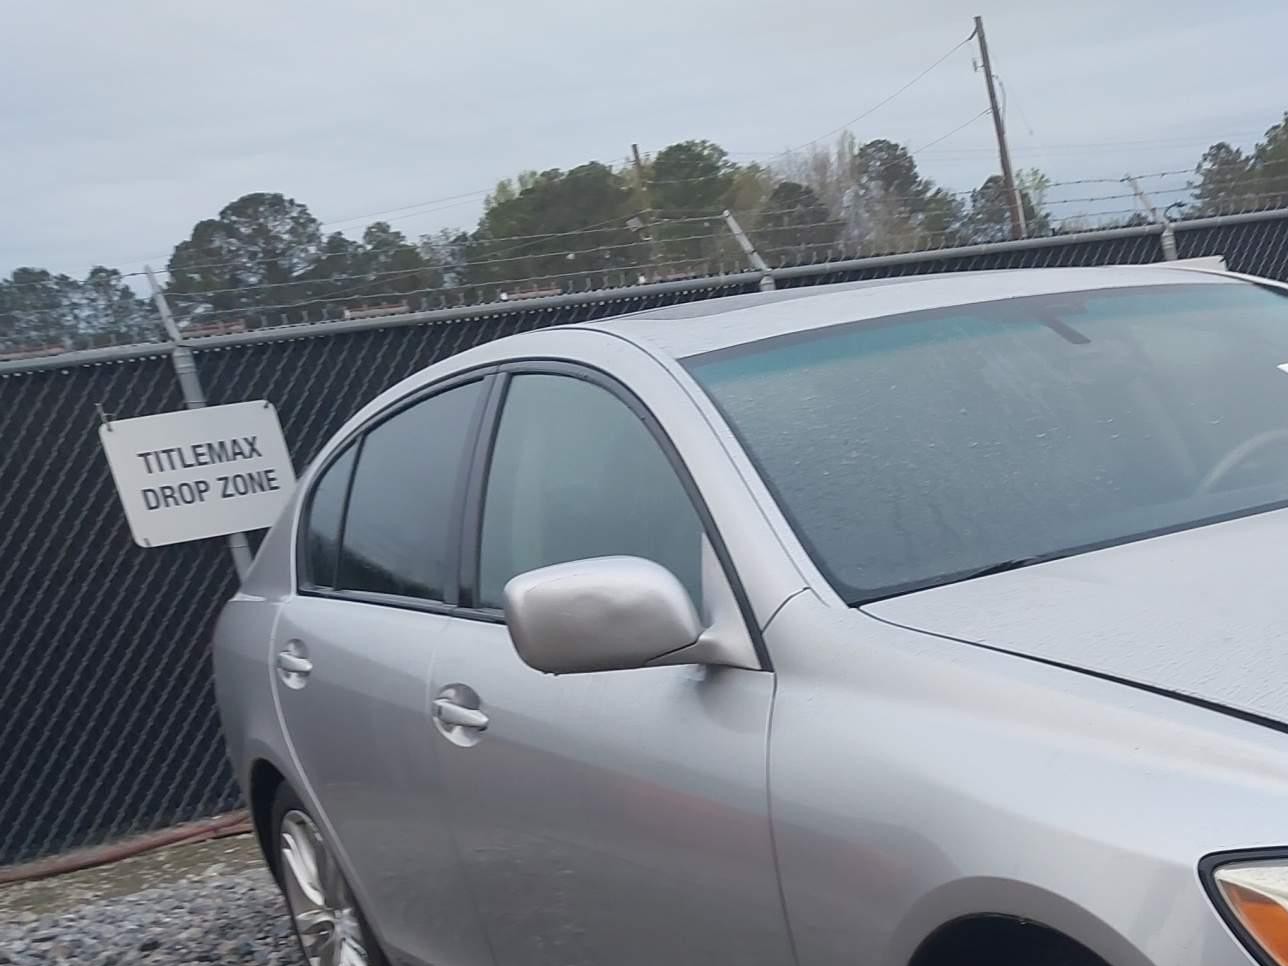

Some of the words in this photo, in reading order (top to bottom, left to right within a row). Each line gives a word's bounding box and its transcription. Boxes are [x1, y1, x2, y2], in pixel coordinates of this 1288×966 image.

[136, 436, 263, 474] TITLEMAX
[141, 480, 210, 511] DROP
[216, 469, 280, 499] ZONE
